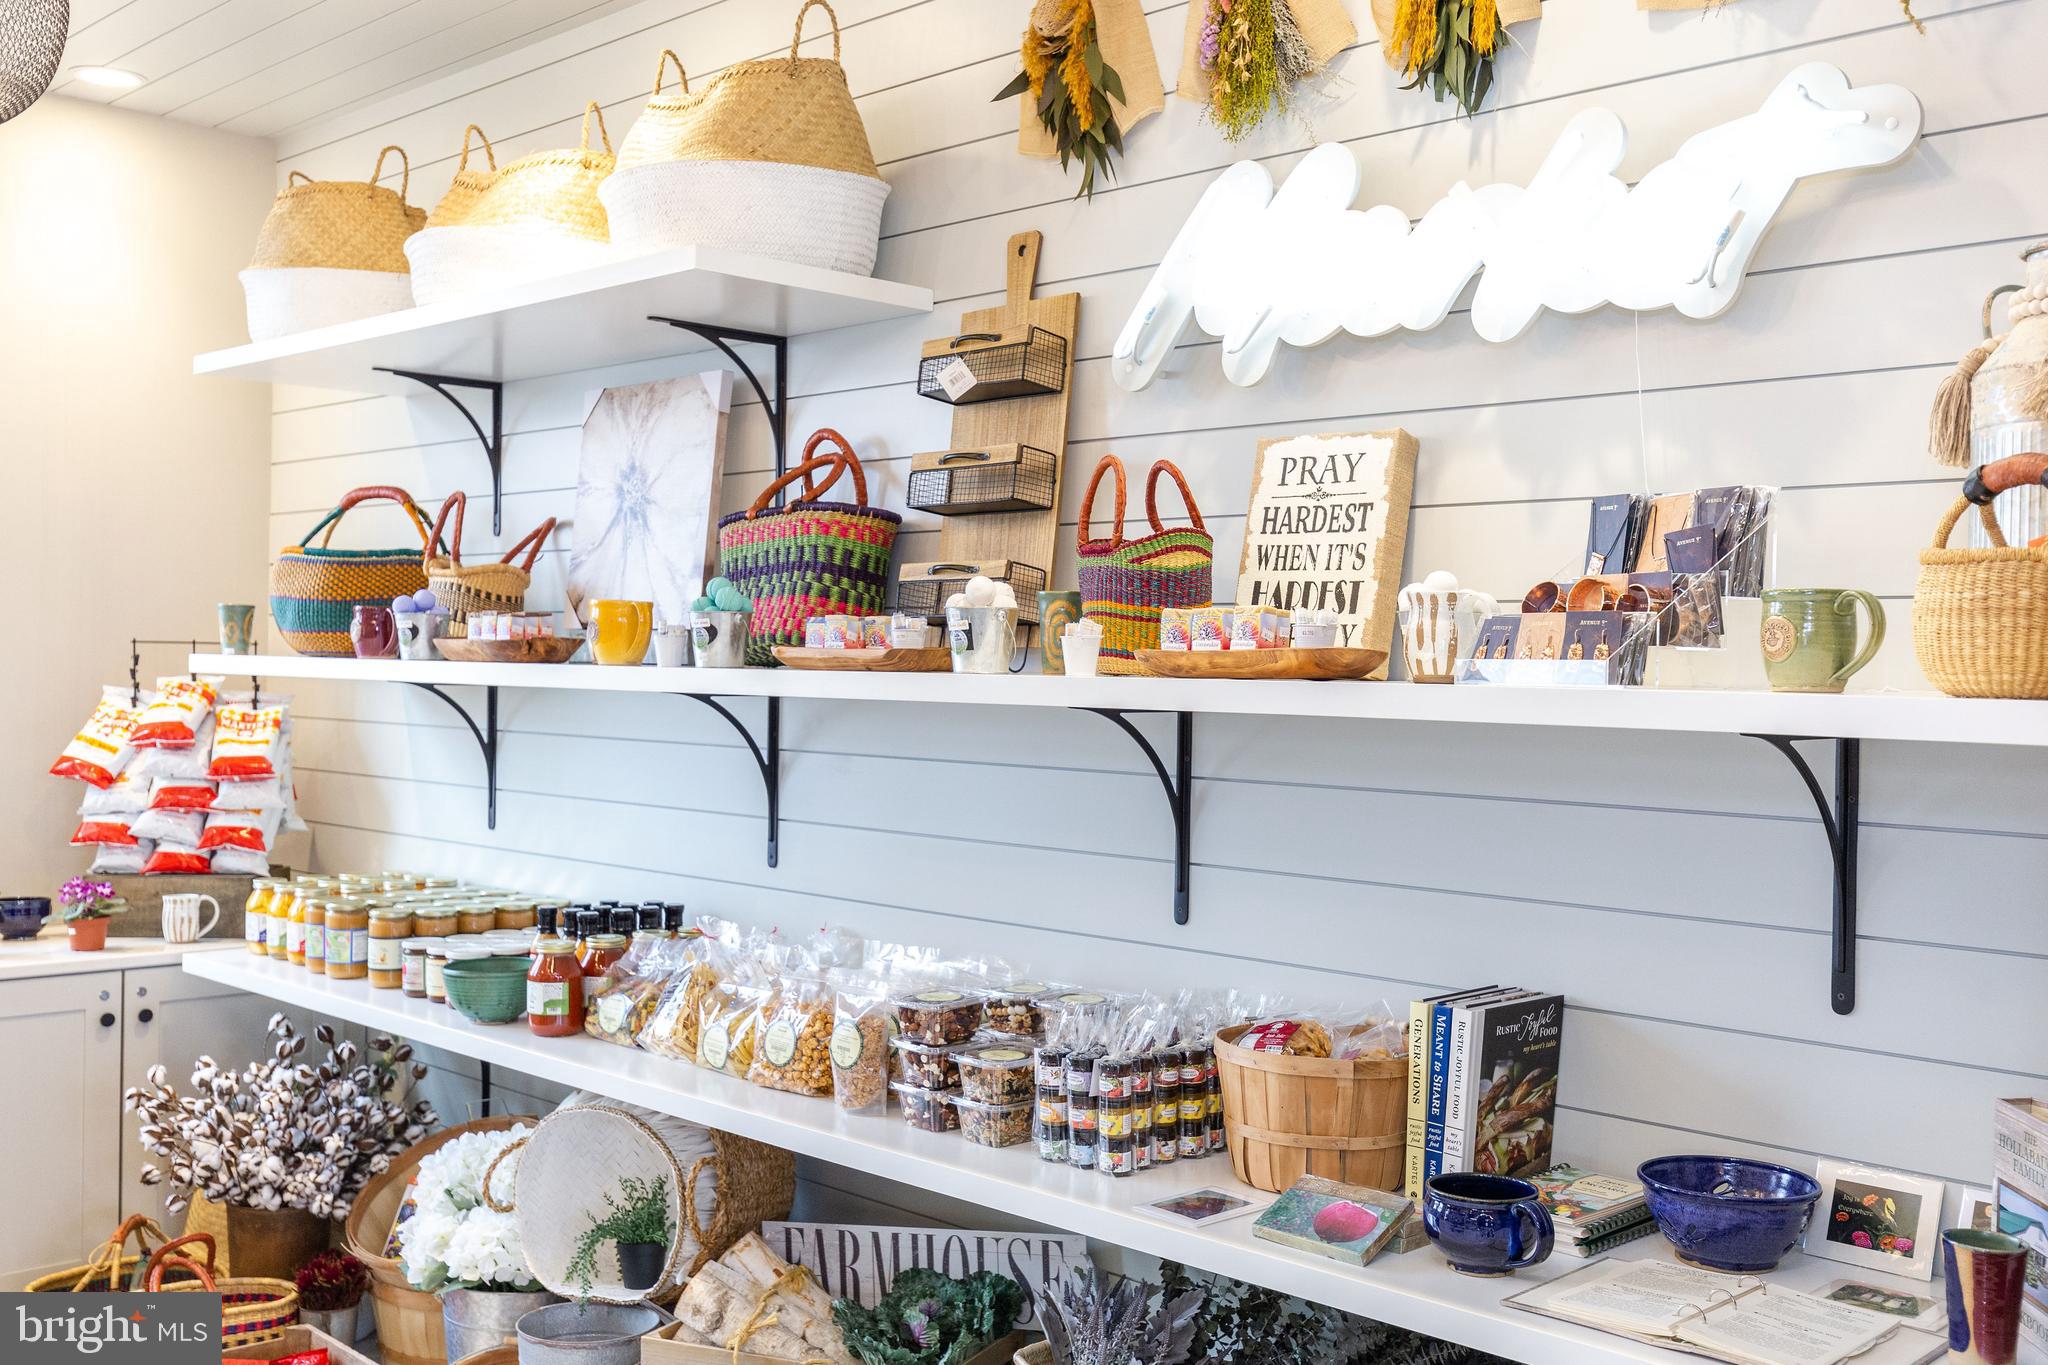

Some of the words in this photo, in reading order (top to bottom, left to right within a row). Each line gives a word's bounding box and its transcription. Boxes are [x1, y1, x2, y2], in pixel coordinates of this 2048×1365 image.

[1277, 452, 1367, 487] PRAY
[1260, 502, 1374, 535] HARDEST
[1257, 543, 1320, 572] WHEN
[1324, 542, 1367, 571] IT'S
[1251, 579, 1365, 615] HARDEST
[1433, 1014, 1447, 1059] MEANT
[1457, 1021, 1466, 1056] RUSTIC
[1412, 1018, 1424, 1105] GENERATIONS
[1434, 1061, 1441, 1071] to
[1454, 1058, 1464, 1092] JOYFUL
[1431, 1074, 1444, 1116] SHARE
[1452, 1094, 1461, 1120] FOOD
[2024, 1130, 2038, 1147] THE
[2013, 1157, 2047, 1188] FAMILY
[1838, 1204, 1873, 1217] everywhere
